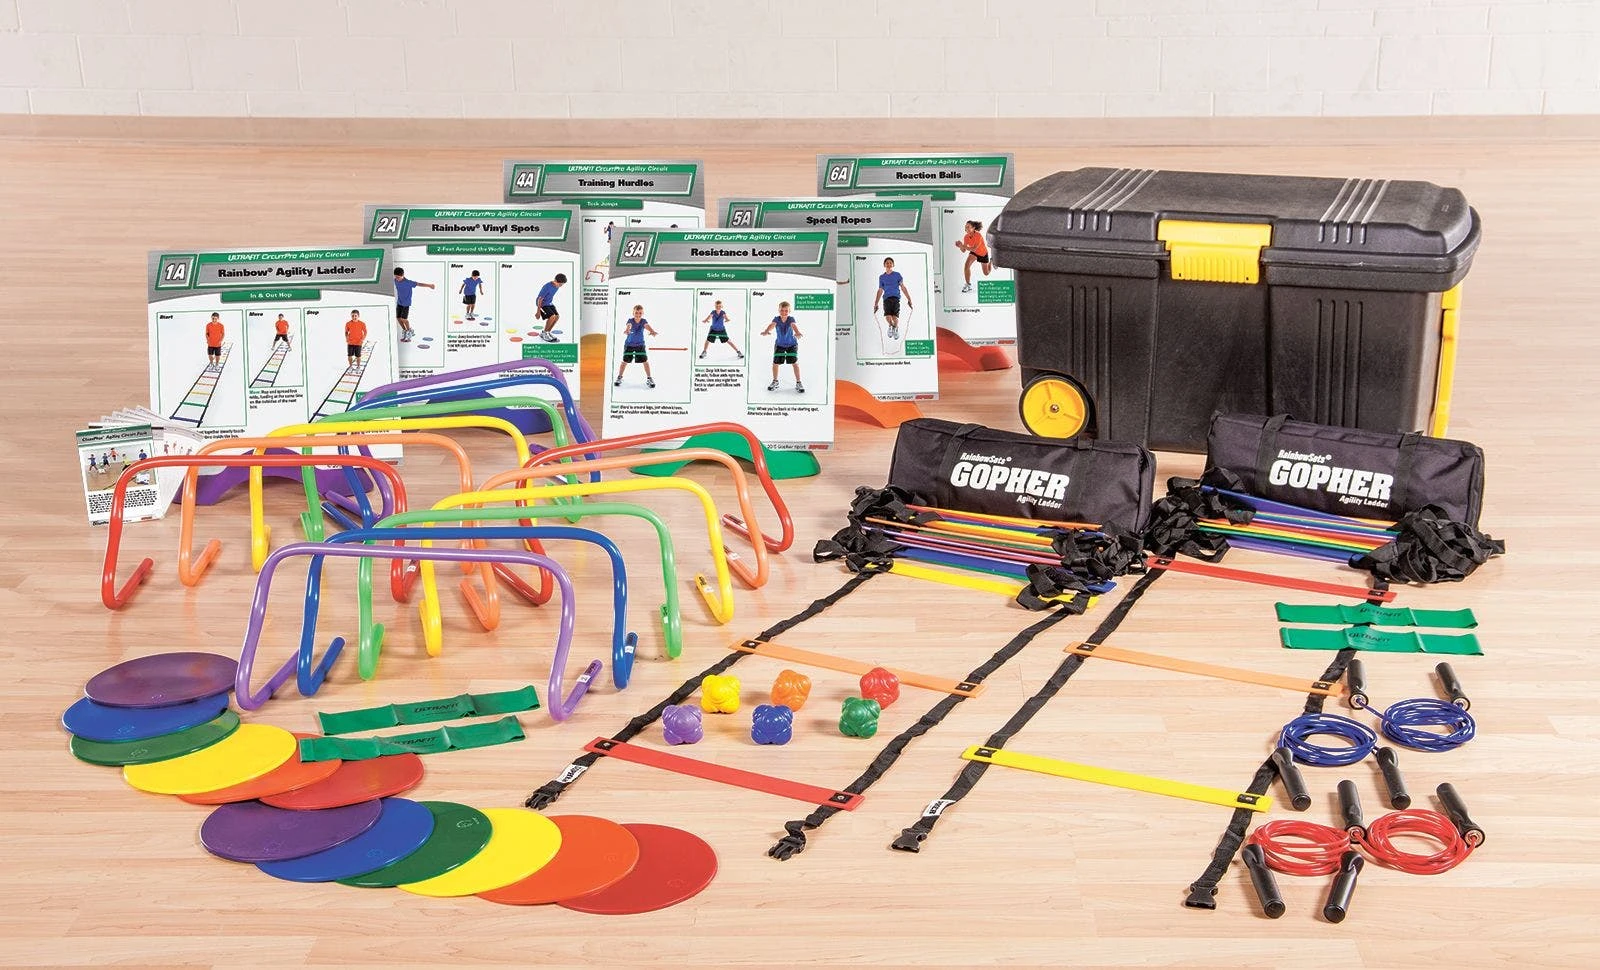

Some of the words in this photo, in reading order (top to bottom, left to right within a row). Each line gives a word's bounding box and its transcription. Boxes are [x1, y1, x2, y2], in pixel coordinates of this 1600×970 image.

[516, 172, 534, 188] 4A
[830, 166, 848, 181] 6A
[896, 171, 937, 180] Reaction
[939, 171, 962, 179] Balls
[578, 179, 615, 188] Training
[617, 179, 654, 187] Hurdles
[376, 217, 398, 233] 2A
[731, 210, 751, 226] 5A
[806, 216, 838, 226] Speed
[840, 216, 872, 225] Ropes
[482, 224, 508, 233] Vinyl
[510, 224, 540, 233] Spots
[624, 240, 646, 258] 3A
[690, 248, 749, 257] Resistance
[751, 248, 784, 258] Loops
[164, 263, 186, 281] 1A
[275, 266, 314, 278] Agility
[316, 265, 356, 275] Ladder
[950, 461, 1070, 500] GOPHER
[1268, 459, 1394, 501] GOPHER
[1016, 494, 1038, 506] Agility
[1038, 498, 1063, 509] Ladder
[1339, 495, 1363, 506] Agility
[1363, 498, 1389, 508] Ladder
